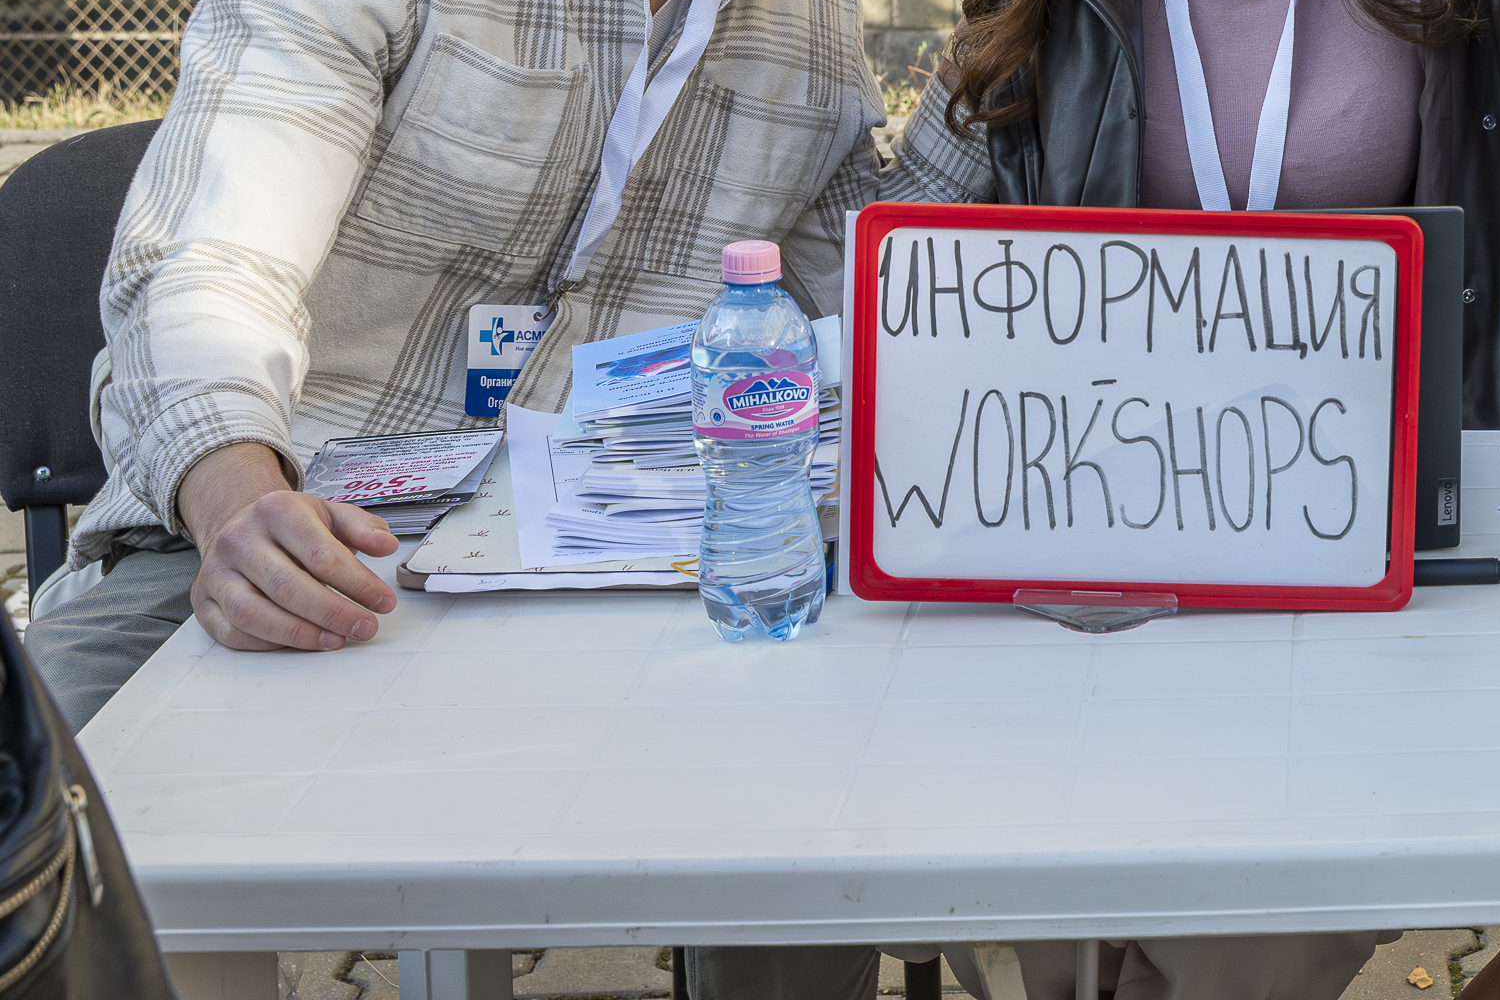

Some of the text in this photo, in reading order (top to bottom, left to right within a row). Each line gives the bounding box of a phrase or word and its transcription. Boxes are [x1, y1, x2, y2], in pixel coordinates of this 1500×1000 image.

[878, 236, 1382, 361] ИНФОРМАЦИЯ
[732, 388, 808, 409] MIHALKOVO
[750, 419, 795, 431] SPRING WATER
[874, 387, 1358, 541] WORKSHOPS
[343, 474, 426, 493] -5%
[1441, 482, 1453, 522] Lenovo
